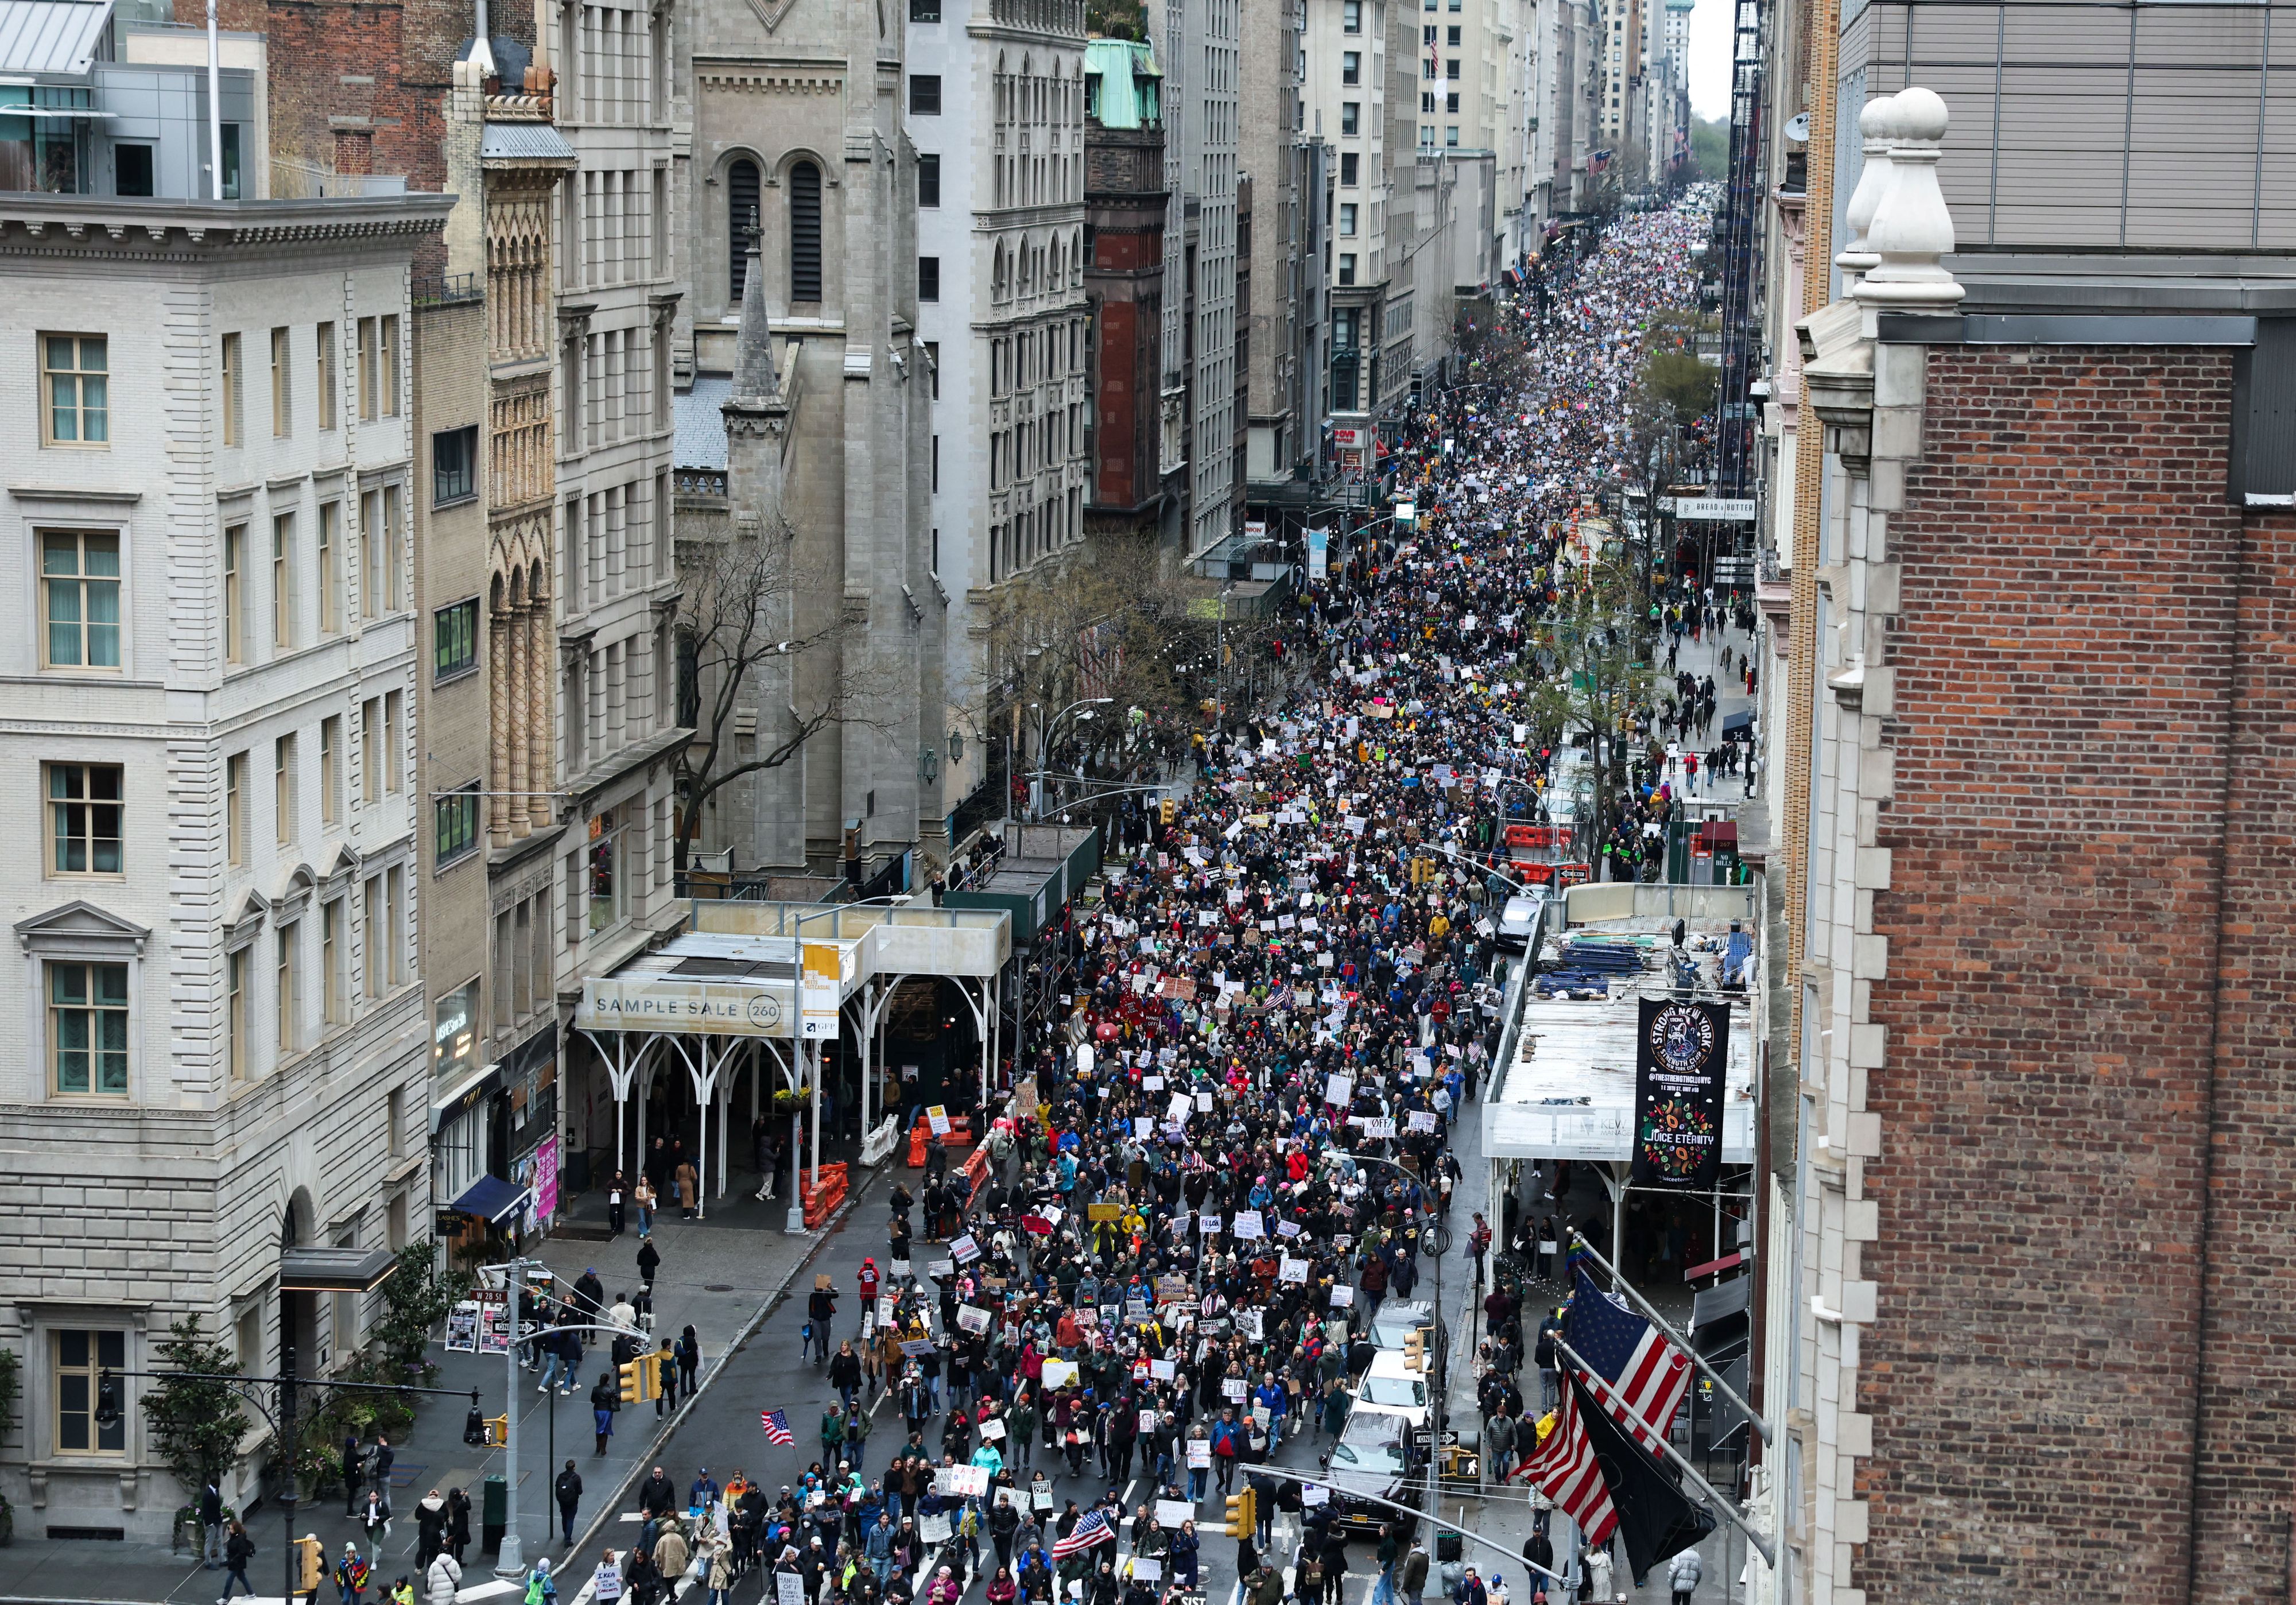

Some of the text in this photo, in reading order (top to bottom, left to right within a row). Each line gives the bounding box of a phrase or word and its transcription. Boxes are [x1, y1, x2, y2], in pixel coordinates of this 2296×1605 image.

[1339, 430, 1355, 438] CVS
[1727, 503, 1752, 511] BUTTER
[1199, 992, 1216, 1000] OFF
[597, 998, 777, 1017] SAMPLE SALE 260
[436, 1020, 454, 1044] LASHES
[1653, 1006, 1712, 1049] STRONG NEW YORK
[1661, 1049, 1688, 1067] STRENGTH
[1411, 1122, 1425, 1130] KEEP
[1601, 1119, 1627, 1129] KEW
[1366, 1127, 1395, 1137] MEDICARE
[1645, 1132, 1715, 1145] JUICE ETERNITY
[956, 1244, 975, 1257] ABOLISH
[957, 1249, 979, 1262] BILLIONAIRES
[966, 1307, 982, 1316] SOS
[520, 1323, 532, 1331] WAY
[1151, 1370, 1174, 1378] TROUBLE
[1223, 1380, 1247, 1395] FELON
[778, 1575, 799, 1584] HANDS
[1167, 1595, 1206, 1605] RSIST
